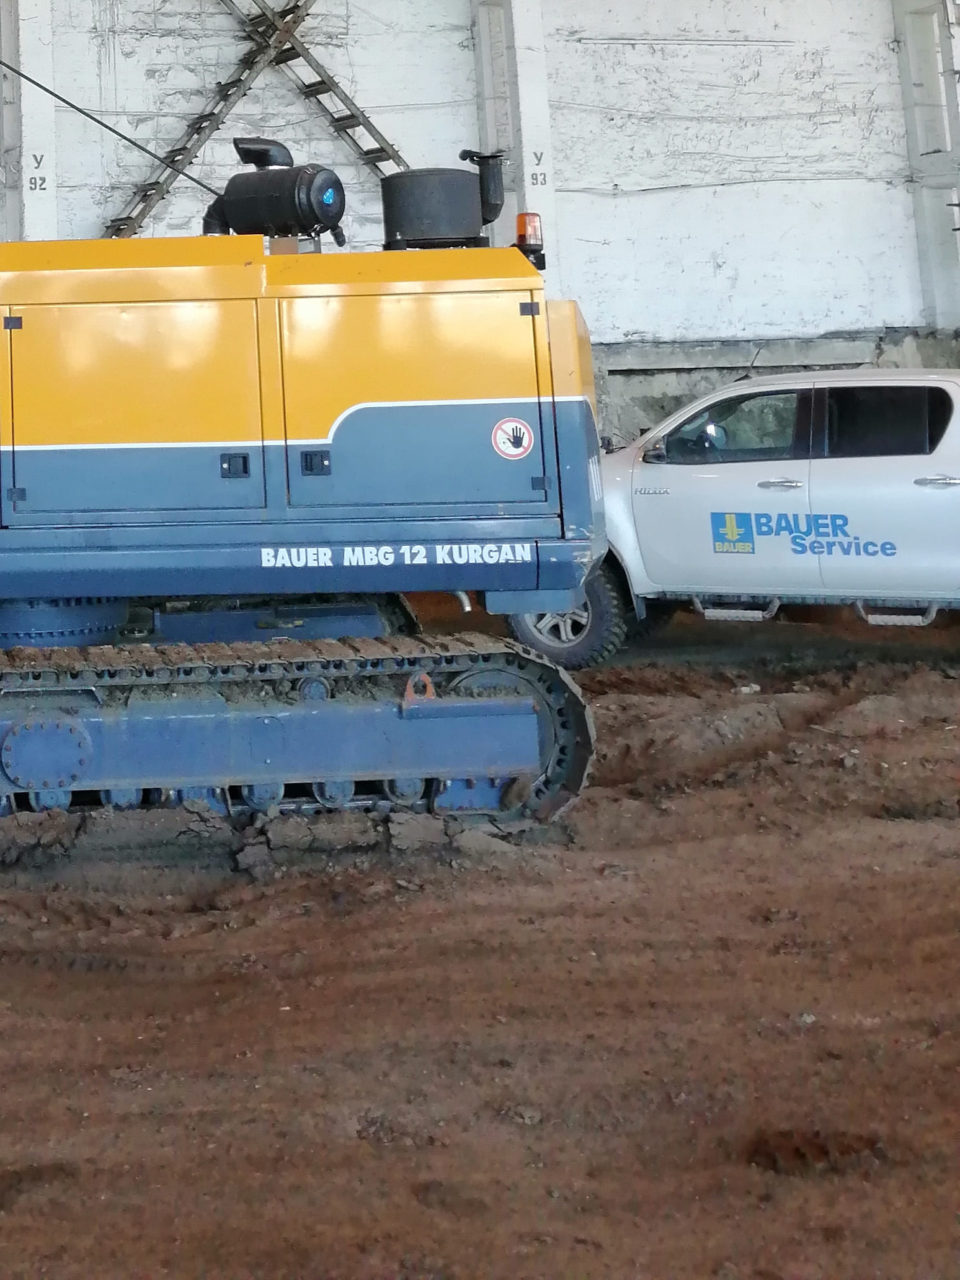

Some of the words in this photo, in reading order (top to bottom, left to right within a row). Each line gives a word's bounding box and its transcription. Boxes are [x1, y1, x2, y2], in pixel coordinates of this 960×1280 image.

[29, 176, 47, 191] 92
[531, 172, 547, 186] 93
[753, 512, 851, 538] BAUER
[261, 547, 333, 567] BAUER
[343, 546, 395, 566] MBG
[399, 545, 428, 565] 12
[436, 543, 532, 565] KURGAN
[714, 541, 753, 554] BAUER
[790, 535, 897, 557] Service
